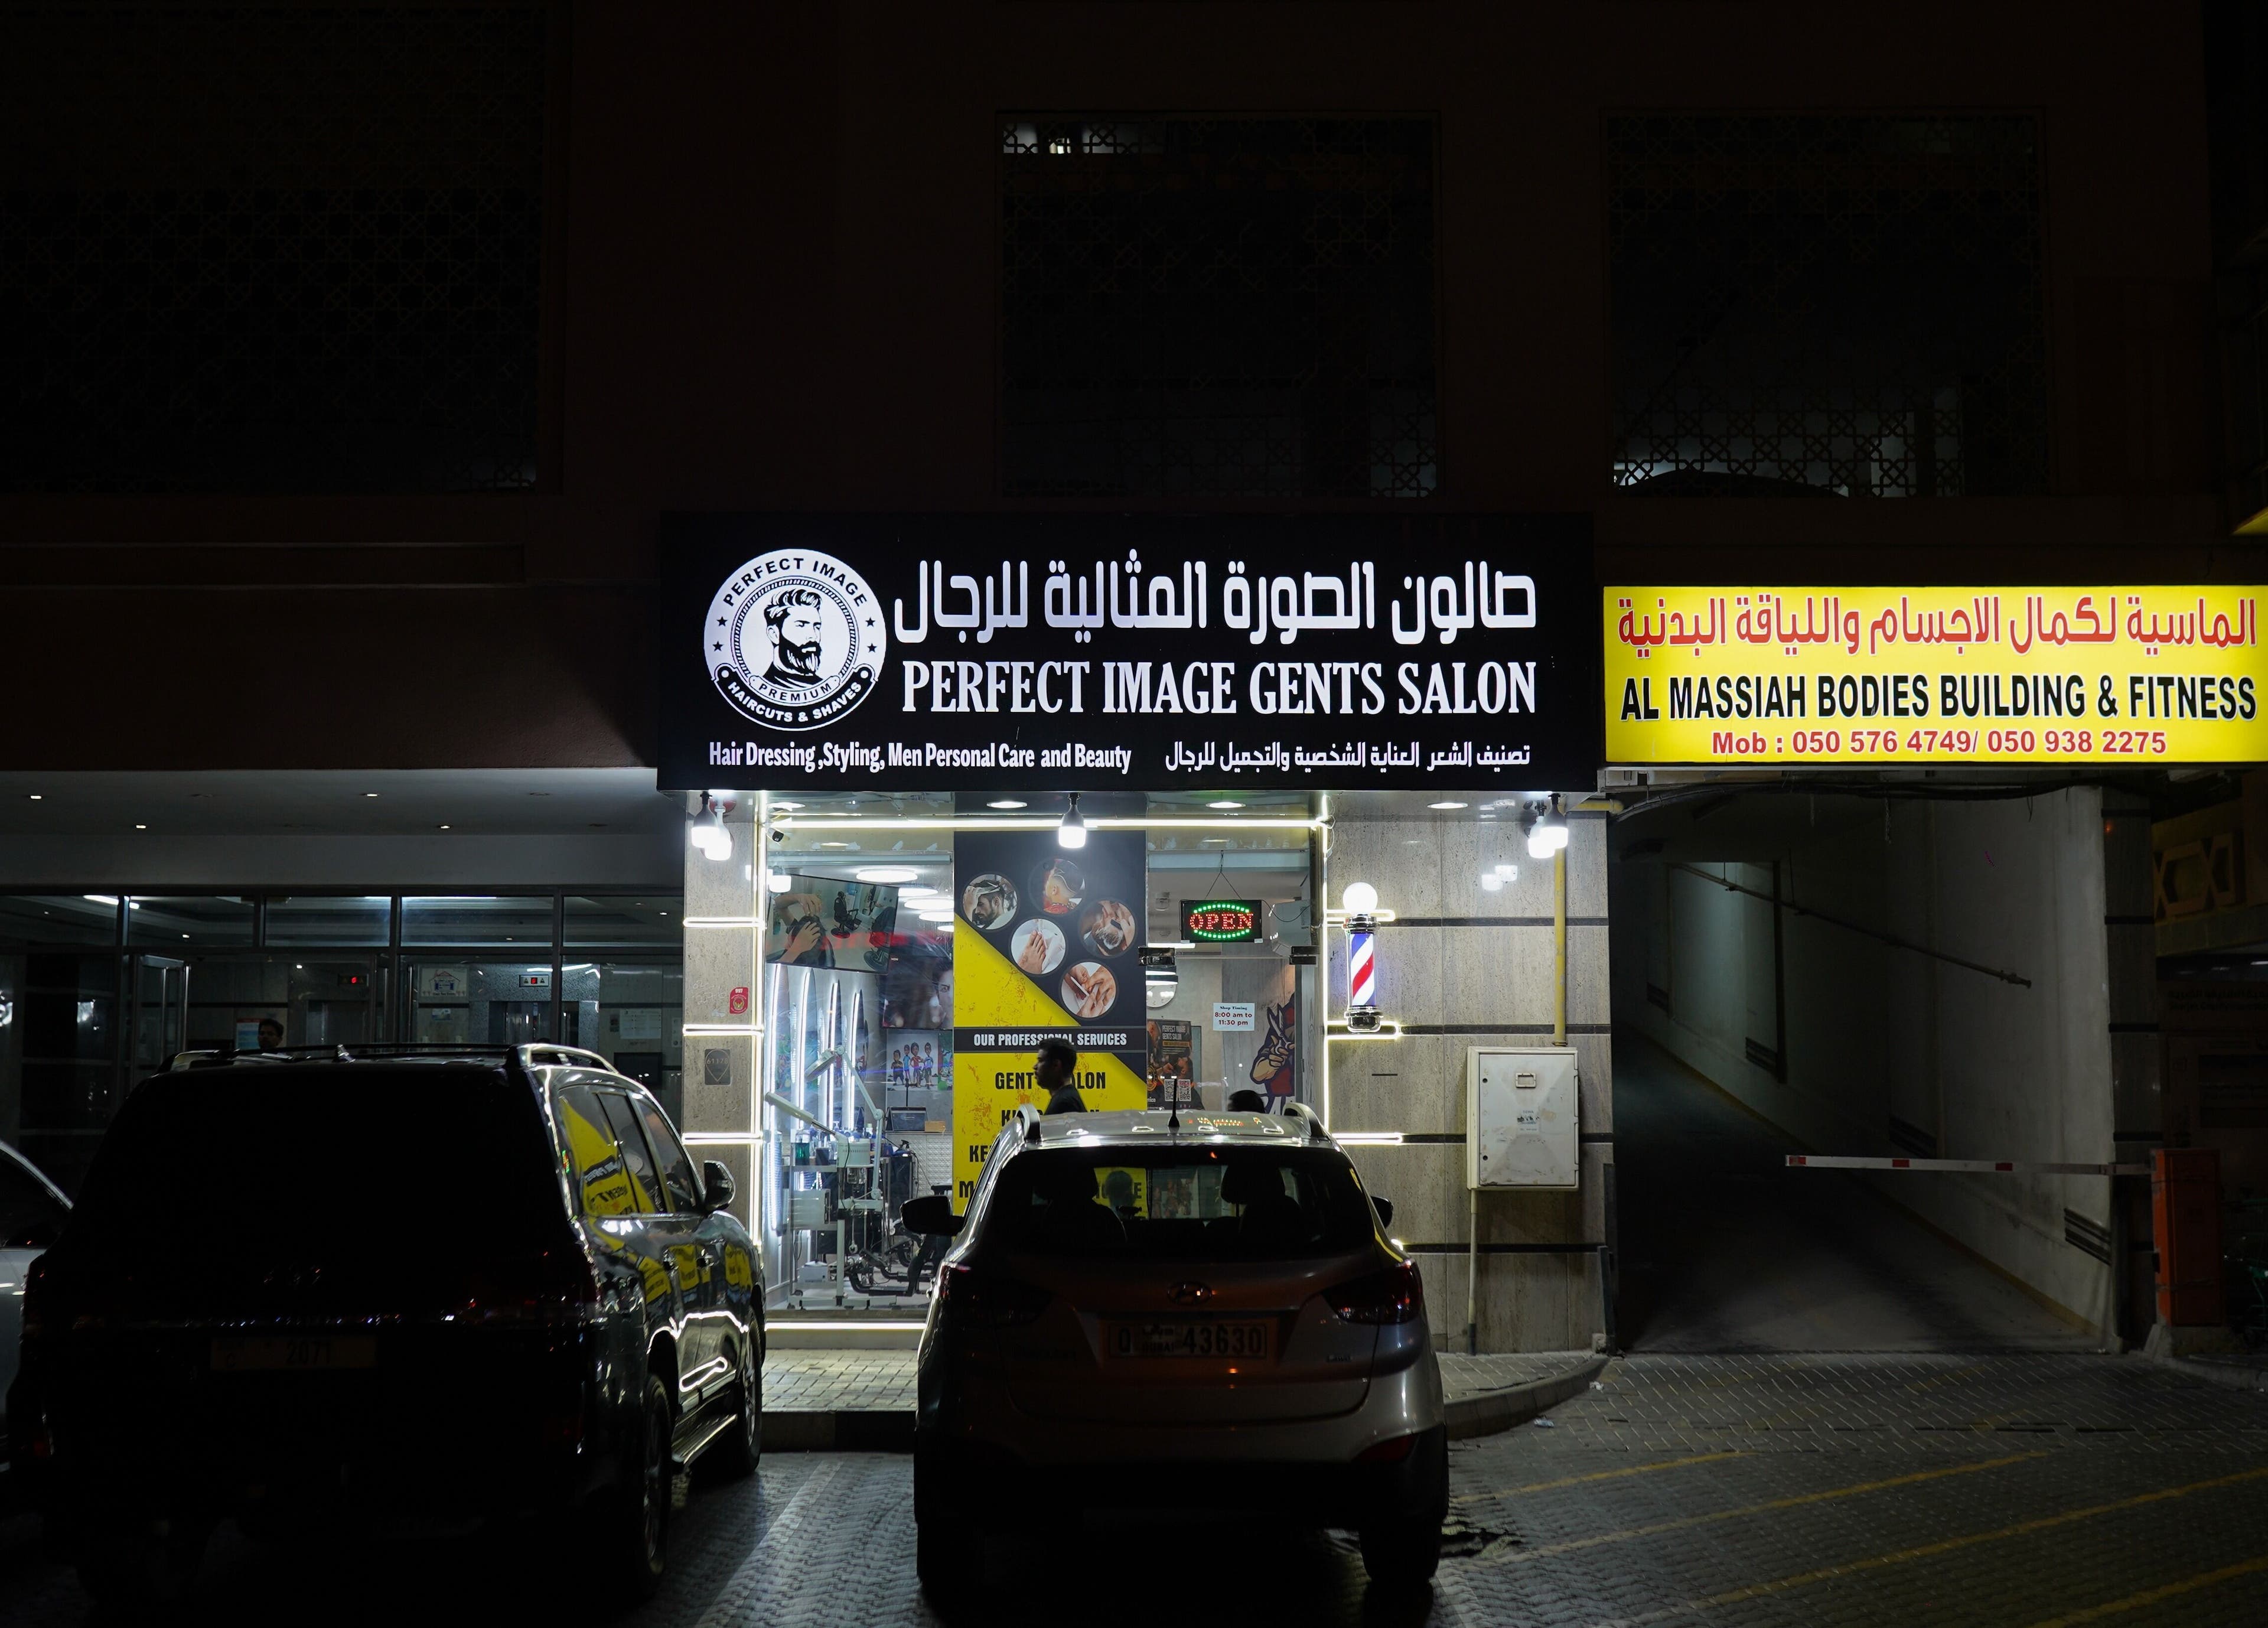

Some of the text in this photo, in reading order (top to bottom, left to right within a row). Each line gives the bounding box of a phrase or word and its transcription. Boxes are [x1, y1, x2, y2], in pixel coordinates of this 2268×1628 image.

[722, 558, 868, 607] PERFECT IMAGE
[894, 548, 1536, 645] صالون الصورة المثالية للرجال
[1619, 595, 2256, 657] الماسية لكمال الاجسام واللياقة البدنية
[727, 681, 862, 723] HAIRCUTS & SHAVES
[758, 682, 833, 702] PREMIUM
[902, 660, 1536, 715] PERFECT IMAGE GENTS SALON
[1621, 675, 2256, 720] AL MASSIAH BODIES BUILDING & FITNESS
[709, 741, 744, 766] Hair
[746, 741, 816, 773] Dressing
[888, 742, 923, 767] Men
[926, 743, 995, 767] Personal
[998, 743, 1035, 767] Care
[1040, 743, 1071, 767] and
[1074, 743, 1132, 775] Beauty
[1165, 741, 1530, 773] تصنيف الشعر العناية الشخصية والتجميل للرجال
[1713, 732, 1767, 754] Mob
[1793, 731, 1840, 753] 050
[1850, 731, 1898, 753] 576
[1907, 730, 1977, 753] 4749/
[1987, 730, 2035, 753] 050
[2045, 730, 2093, 753] 938
[2103, 731, 2166, 754] 2275
[1189, 912, 1253, 930] OPEN
[973, 1034, 995, 1046] OUR
[1077, 1033, 1127, 1046] SERVICES
[995, 1072, 1035, 1090] GENT
[1182, 1326, 1262, 1354] 43630
